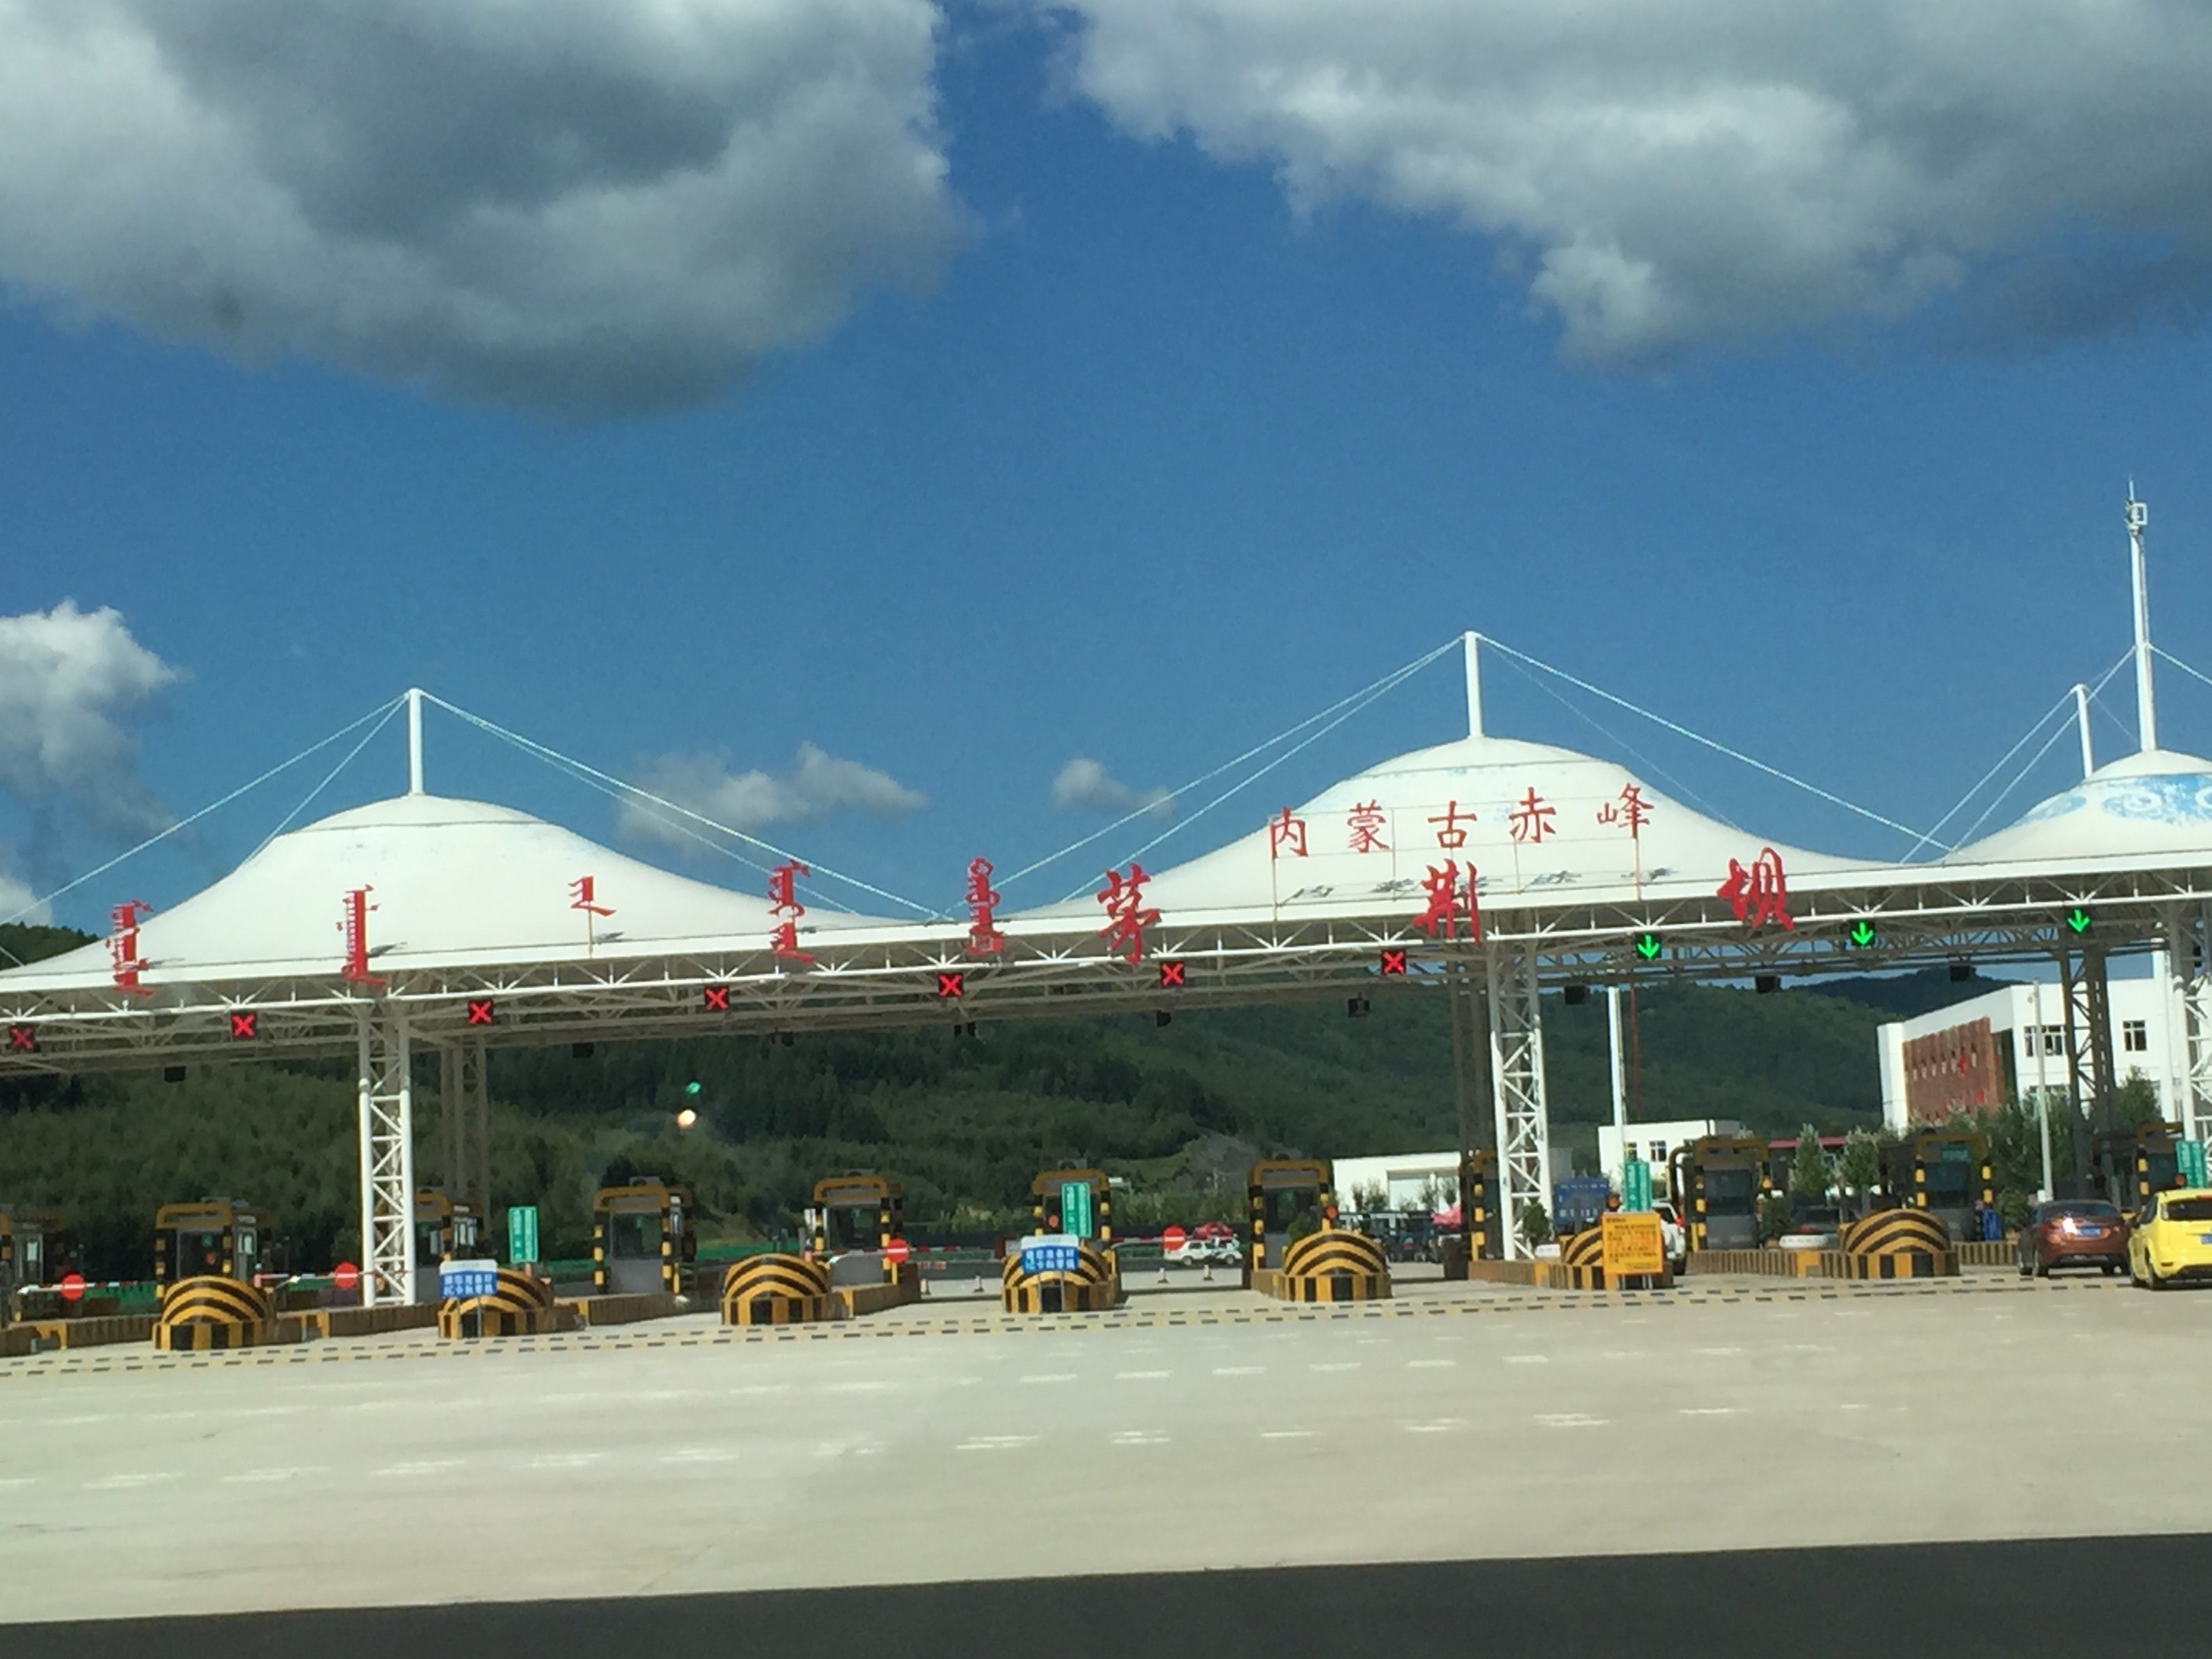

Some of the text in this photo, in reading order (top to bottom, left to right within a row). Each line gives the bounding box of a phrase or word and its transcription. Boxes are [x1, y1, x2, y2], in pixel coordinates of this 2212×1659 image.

[1270, 783, 1654, 859] 内蒙古赤峰
